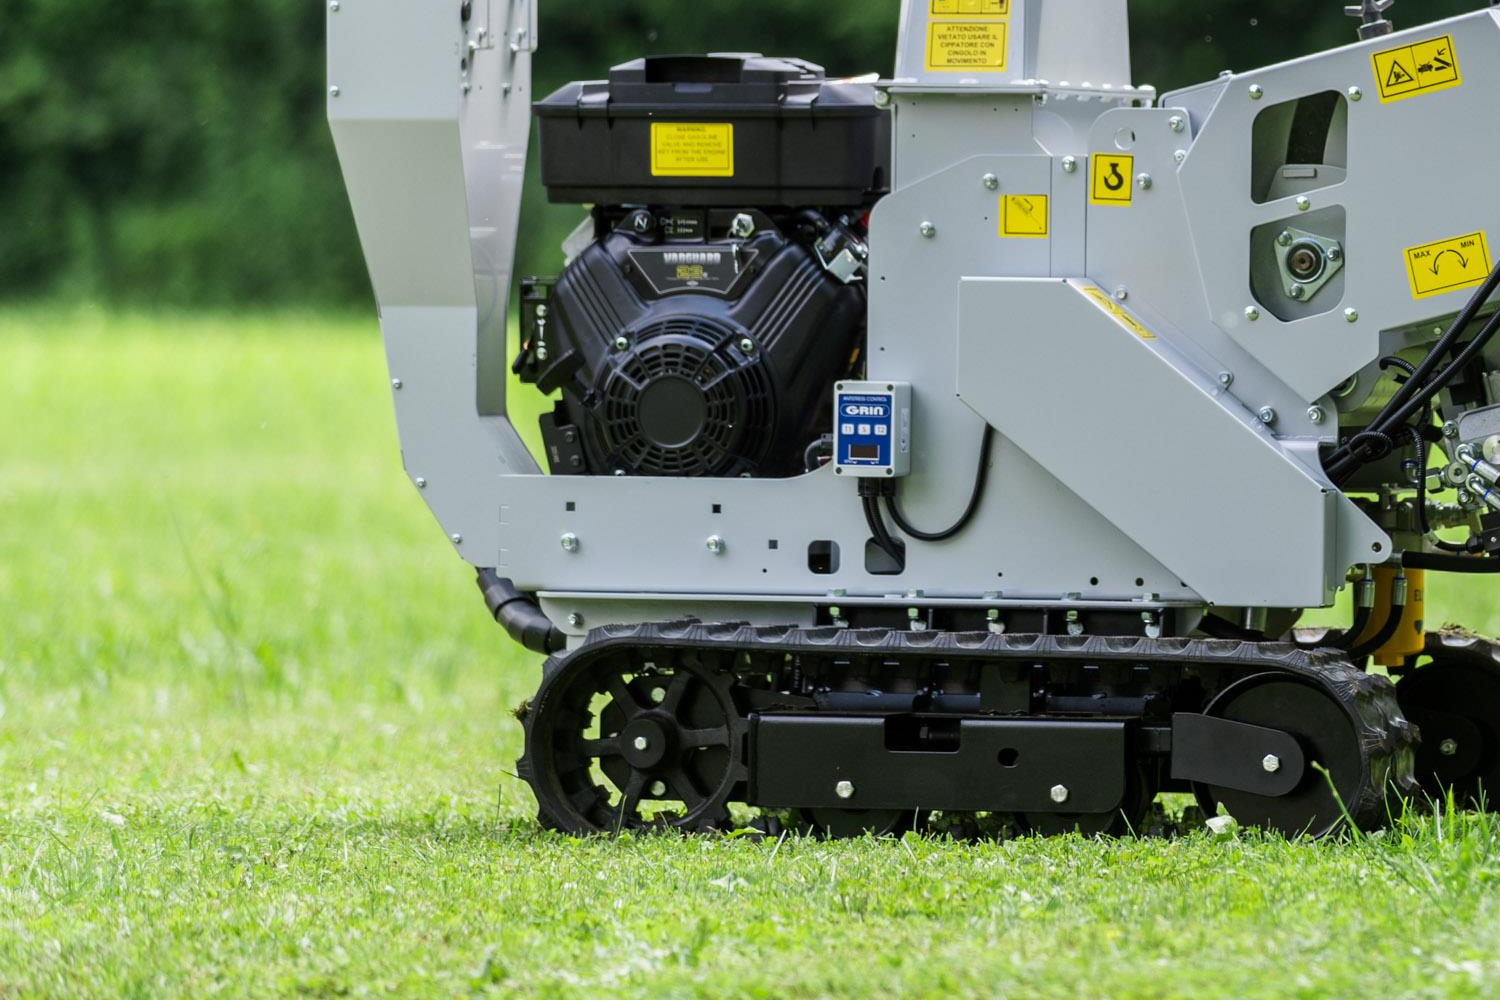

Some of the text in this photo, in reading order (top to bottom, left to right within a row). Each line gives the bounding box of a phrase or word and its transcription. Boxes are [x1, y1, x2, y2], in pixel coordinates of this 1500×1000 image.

[1460, 240, 1475, 248] MIN
[1413, 250, 1431, 259] MAX
[845, 405, 884, 416] GRIN
[877, 426, 885, 434] T2
